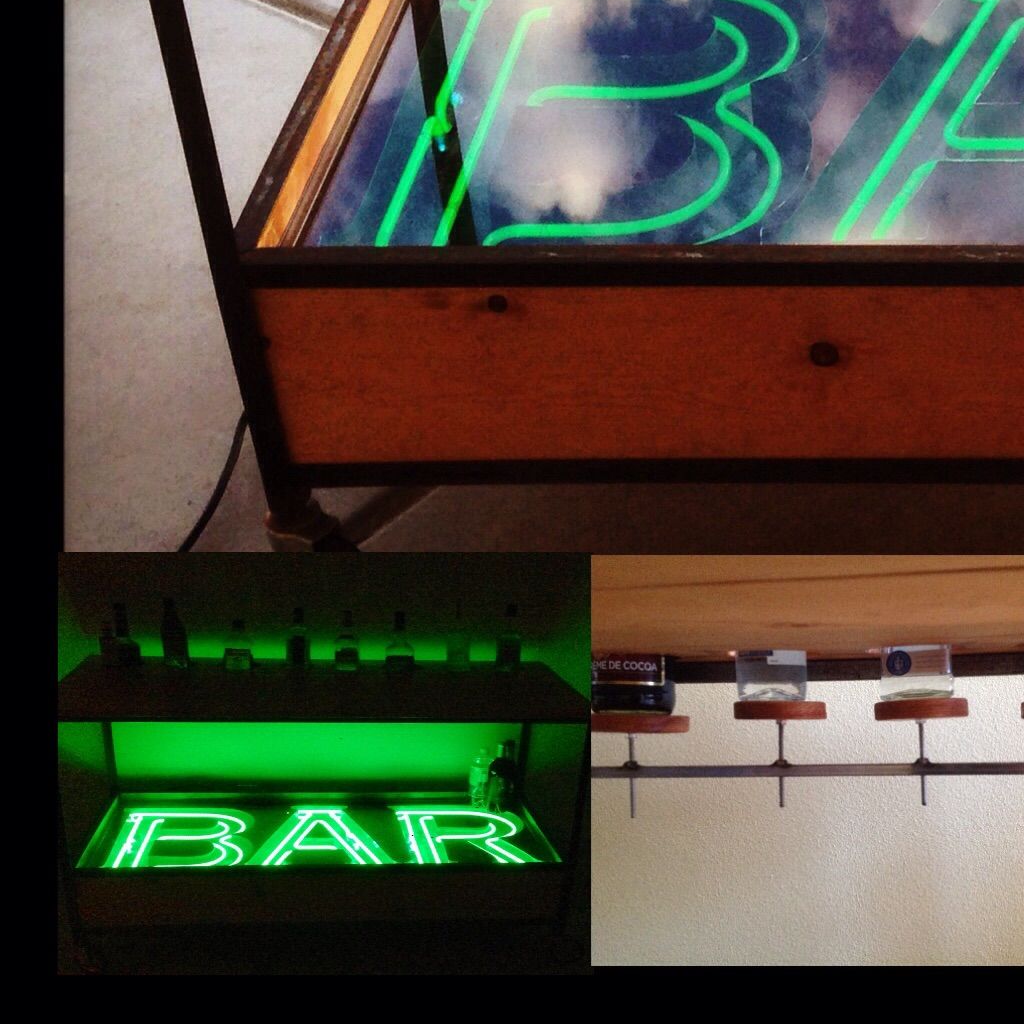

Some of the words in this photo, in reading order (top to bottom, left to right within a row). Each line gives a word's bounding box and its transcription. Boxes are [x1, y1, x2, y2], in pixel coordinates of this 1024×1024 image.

[608, 660, 622, 670] DE
[622, 660, 658, 672] COCOA
[103, 808, 542, 868] BAR
